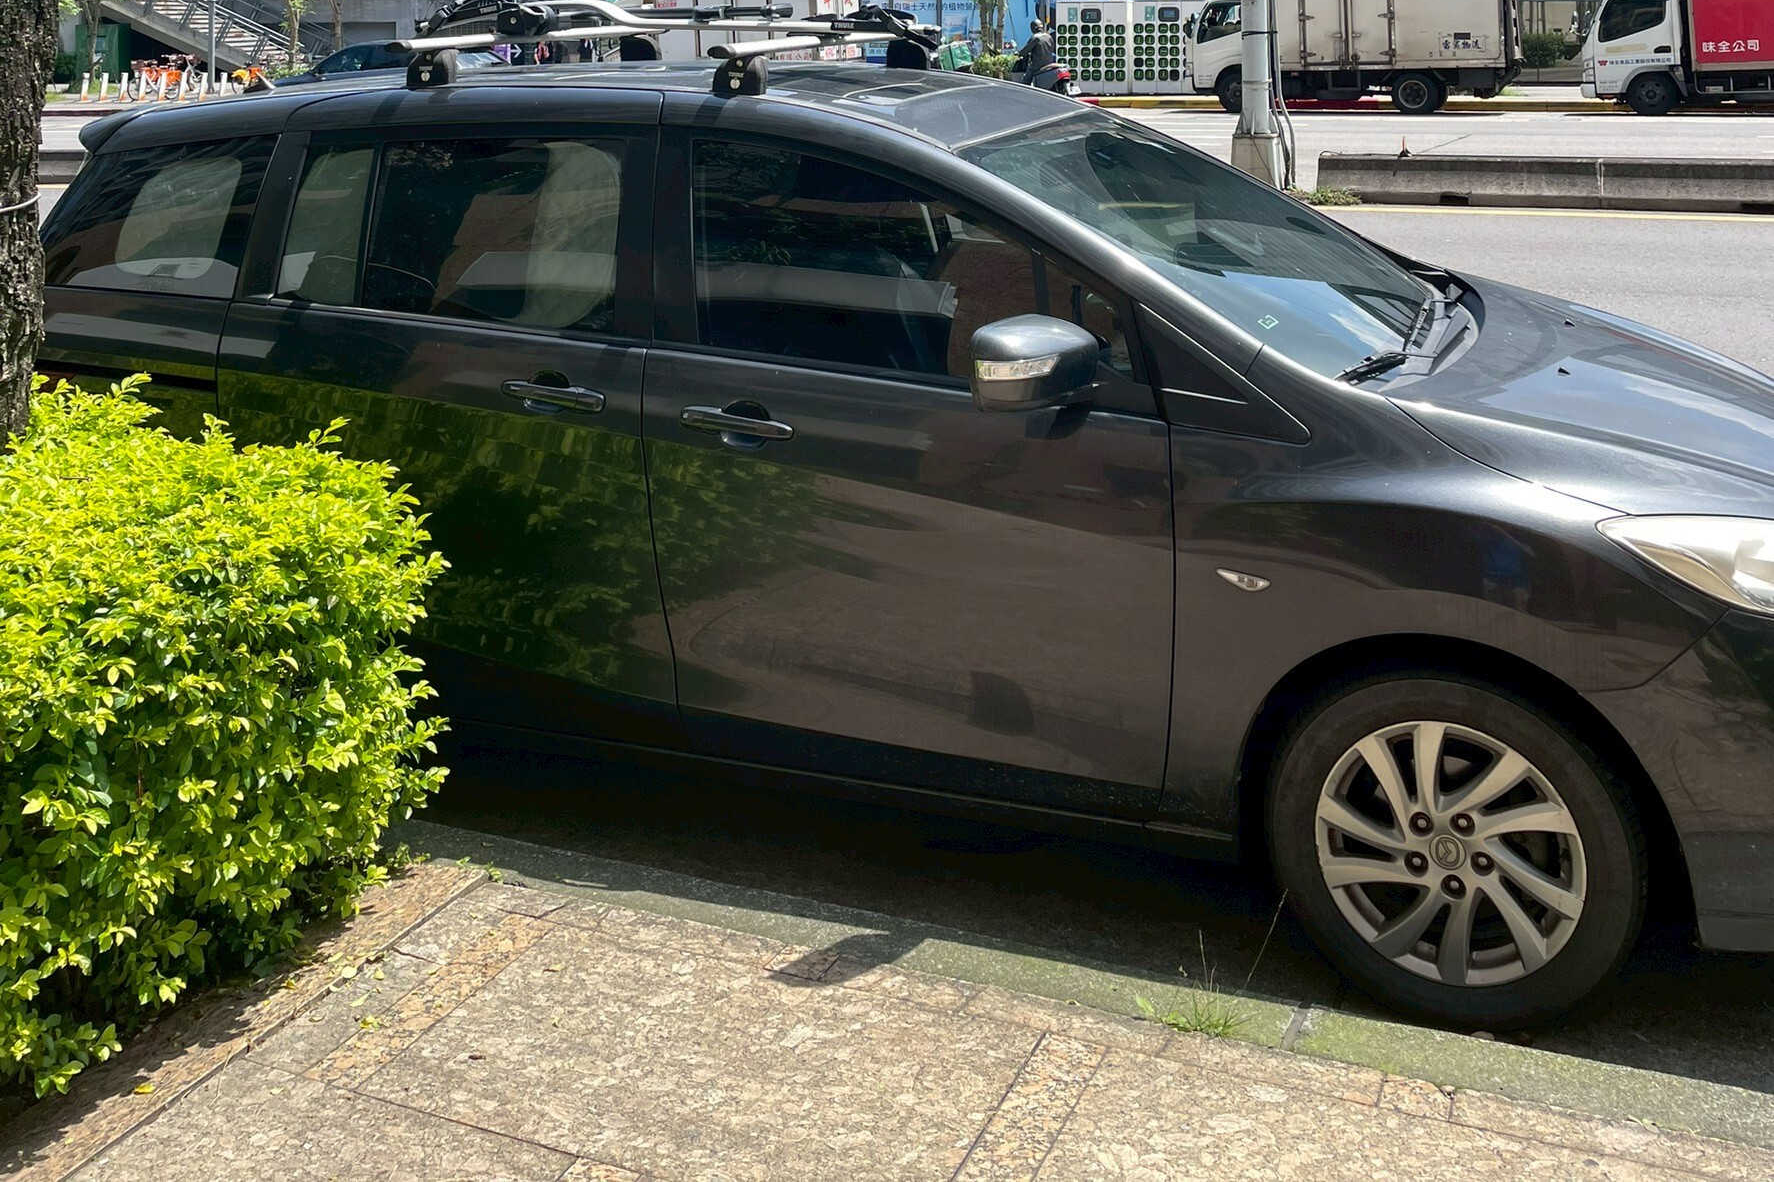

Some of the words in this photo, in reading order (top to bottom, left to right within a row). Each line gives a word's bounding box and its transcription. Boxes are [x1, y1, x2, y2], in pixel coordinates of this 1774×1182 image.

[833, 21, 855, 29] THULE
[1702, 39, 1760, 53] 味全公司
